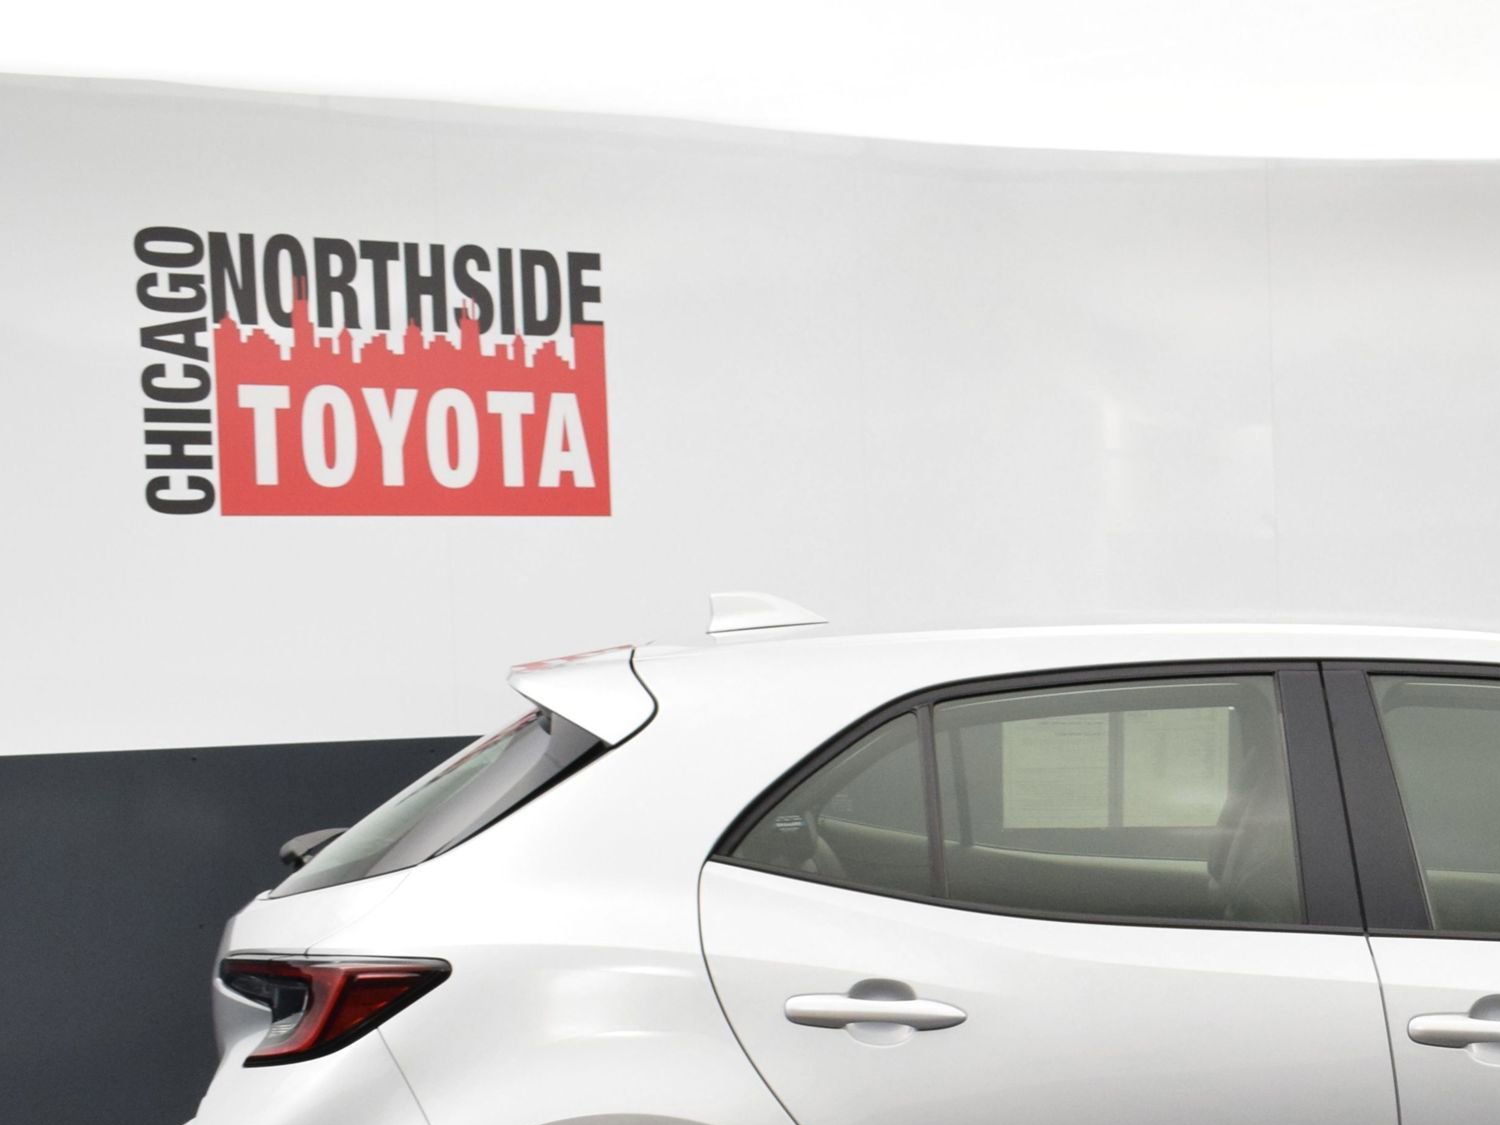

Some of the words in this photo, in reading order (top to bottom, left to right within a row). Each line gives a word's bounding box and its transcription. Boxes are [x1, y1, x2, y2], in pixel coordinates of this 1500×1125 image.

[207, 231, 604, 338] NORTHSIDE
[133, 226, 216, 516] CHICAGO
[237, 384, 596, 489] TOYOTA
